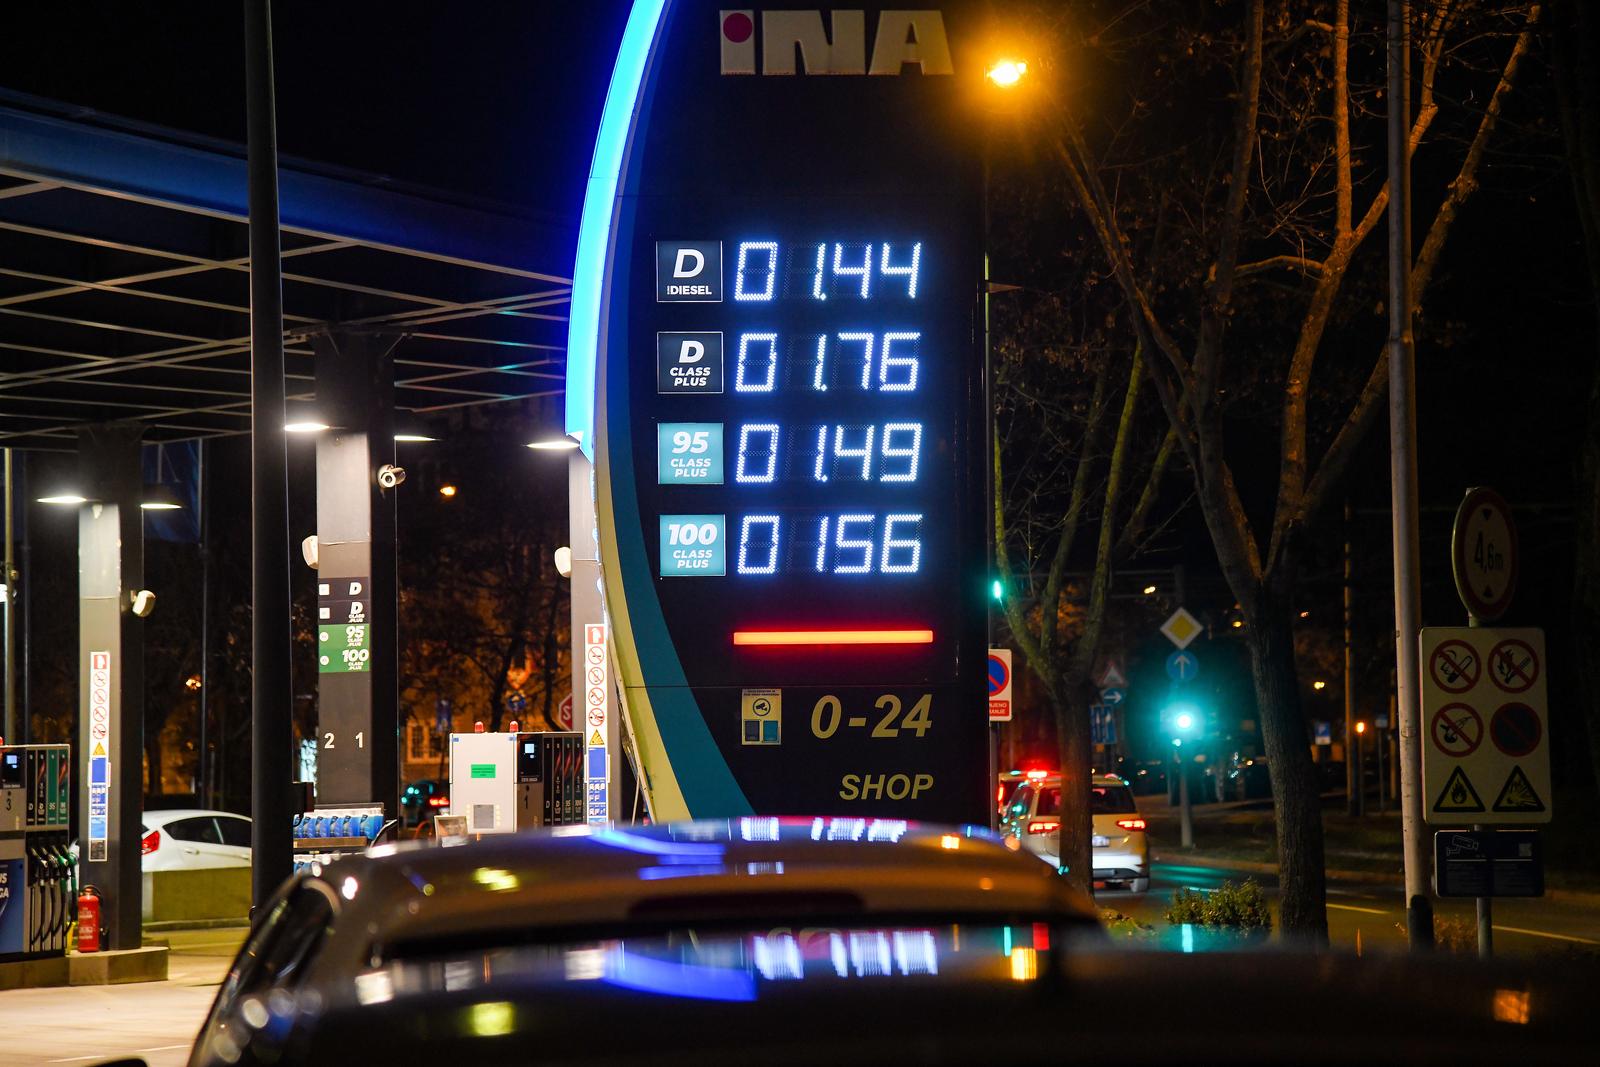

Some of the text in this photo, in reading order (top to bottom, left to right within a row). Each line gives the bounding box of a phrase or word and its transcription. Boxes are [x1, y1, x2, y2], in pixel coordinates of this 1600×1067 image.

[673, 249, 705, 278] D
[679, 340, 705, 363] D
[669, 367, 711, 377] CLASS
[673, 377, 708, 387] PLUS
[671, 431, 710, 454] 95
[670, 458, 712, 468] CLASS
[674, 468, 708, 478] PLUS
[668, 523, 718, 546] 100
[672, 549, 713, 559] CLASS
[676, 559, 709, 569] PLUS
[349, 582, 362, 596] D
[350, 601, 364, 615] D
[345, 625, 365, 639] 95
[342, 648, 370, 663] 100
[324, 731, 364, 749] 2 1
[839, 773, 935, 800] SHOP
[6, 798, 12, 811] 3
